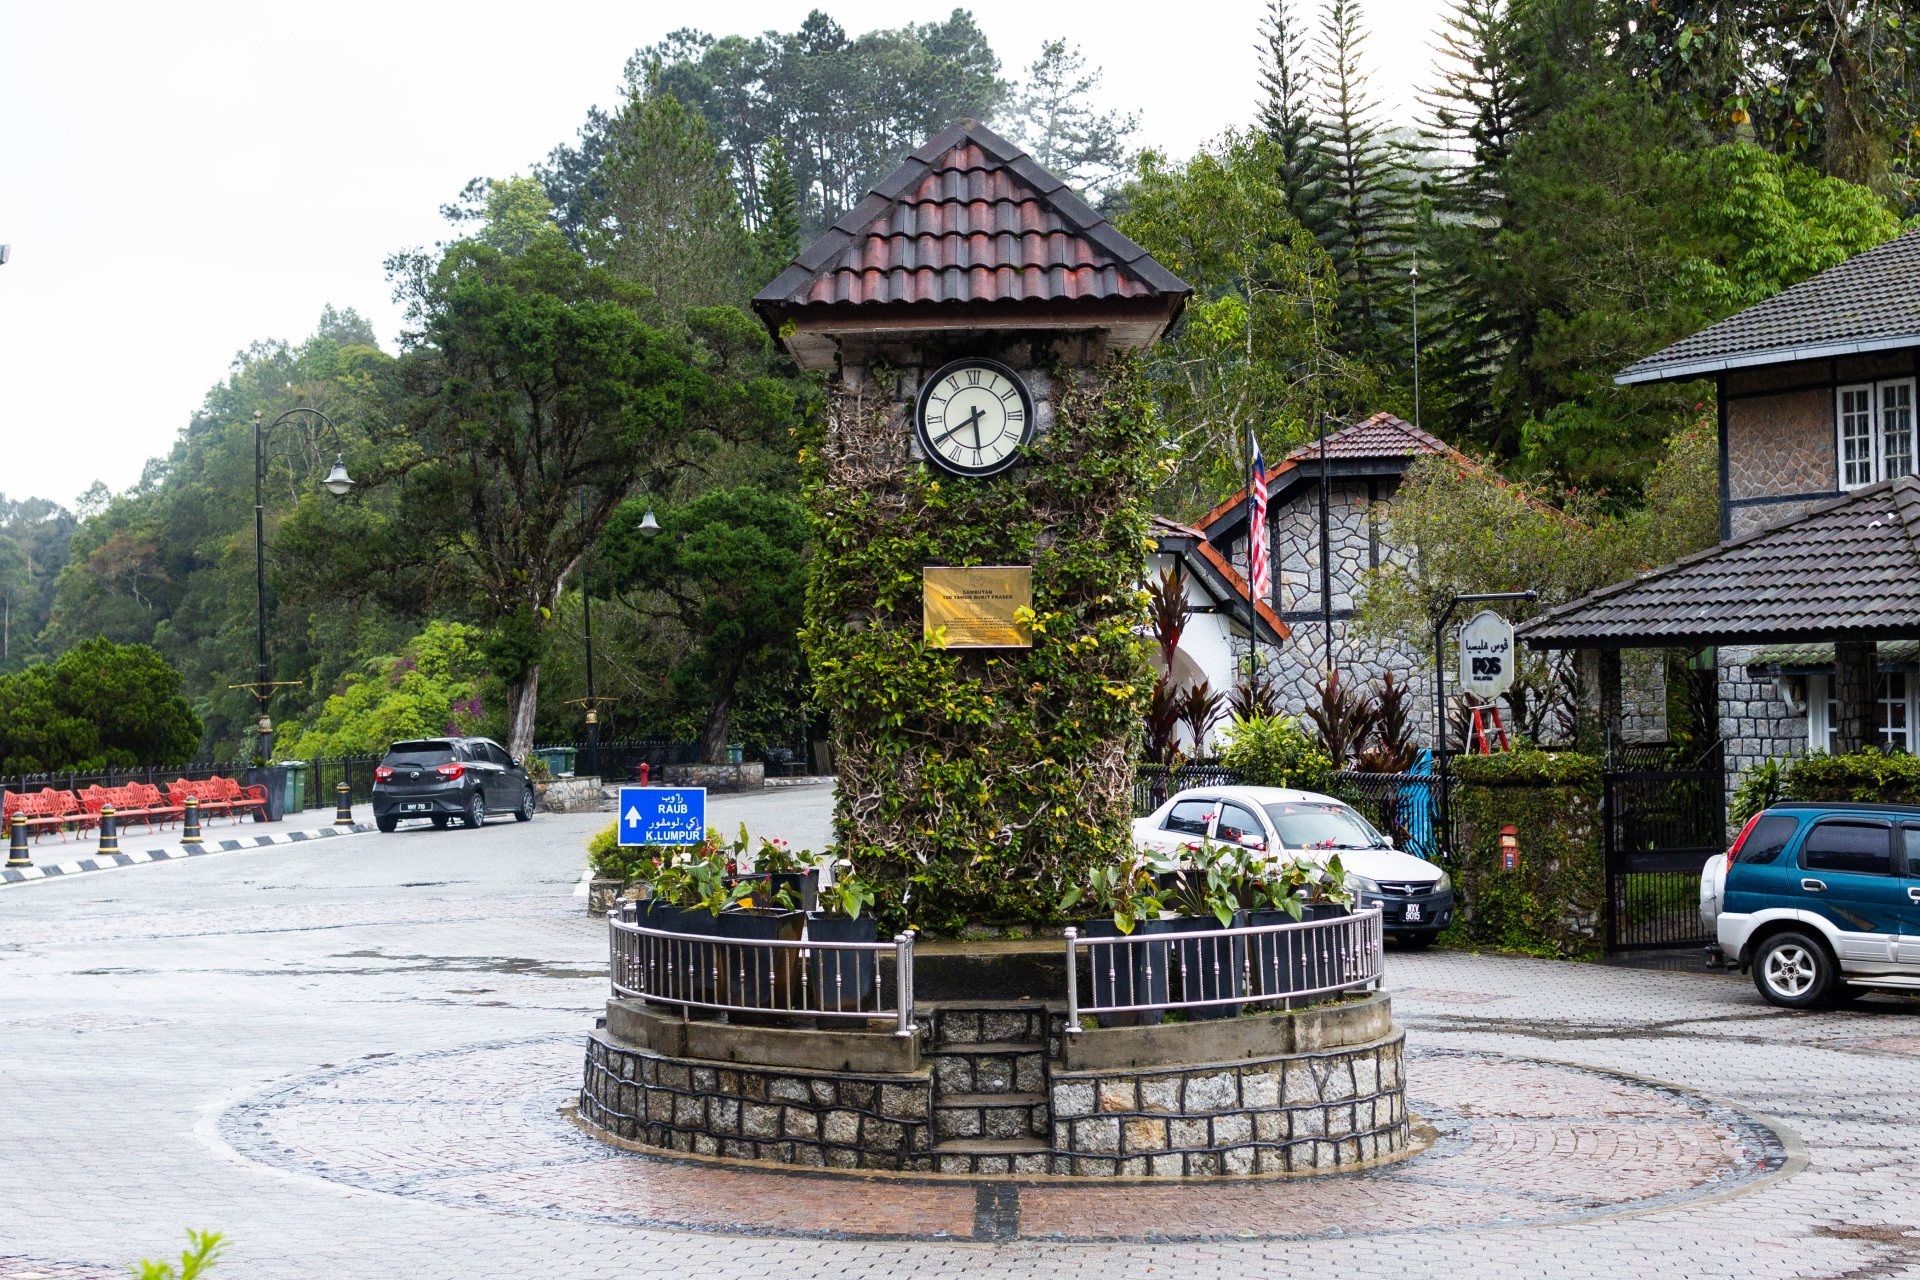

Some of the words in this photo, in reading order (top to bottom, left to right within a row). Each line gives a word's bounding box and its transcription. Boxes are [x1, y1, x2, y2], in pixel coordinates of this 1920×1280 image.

[946, 375, 960, 392] XI
[965, 370, 981, 385] XII
[989, 374, 999, 389] I
[931, 392, 947, 405] X
[1001, 387, 1017, 402] II
[927, 414, 943, 425] IX
[1007, 409, 1023, 422] III
[948, 445, 963, 462] VII
[992, 445, 1004, 460] V
[1472, 656, 1502, 675] POS
[658, 804, 688, 814] RAUB
[646, 830, 700, 840] K.LUMPUR
